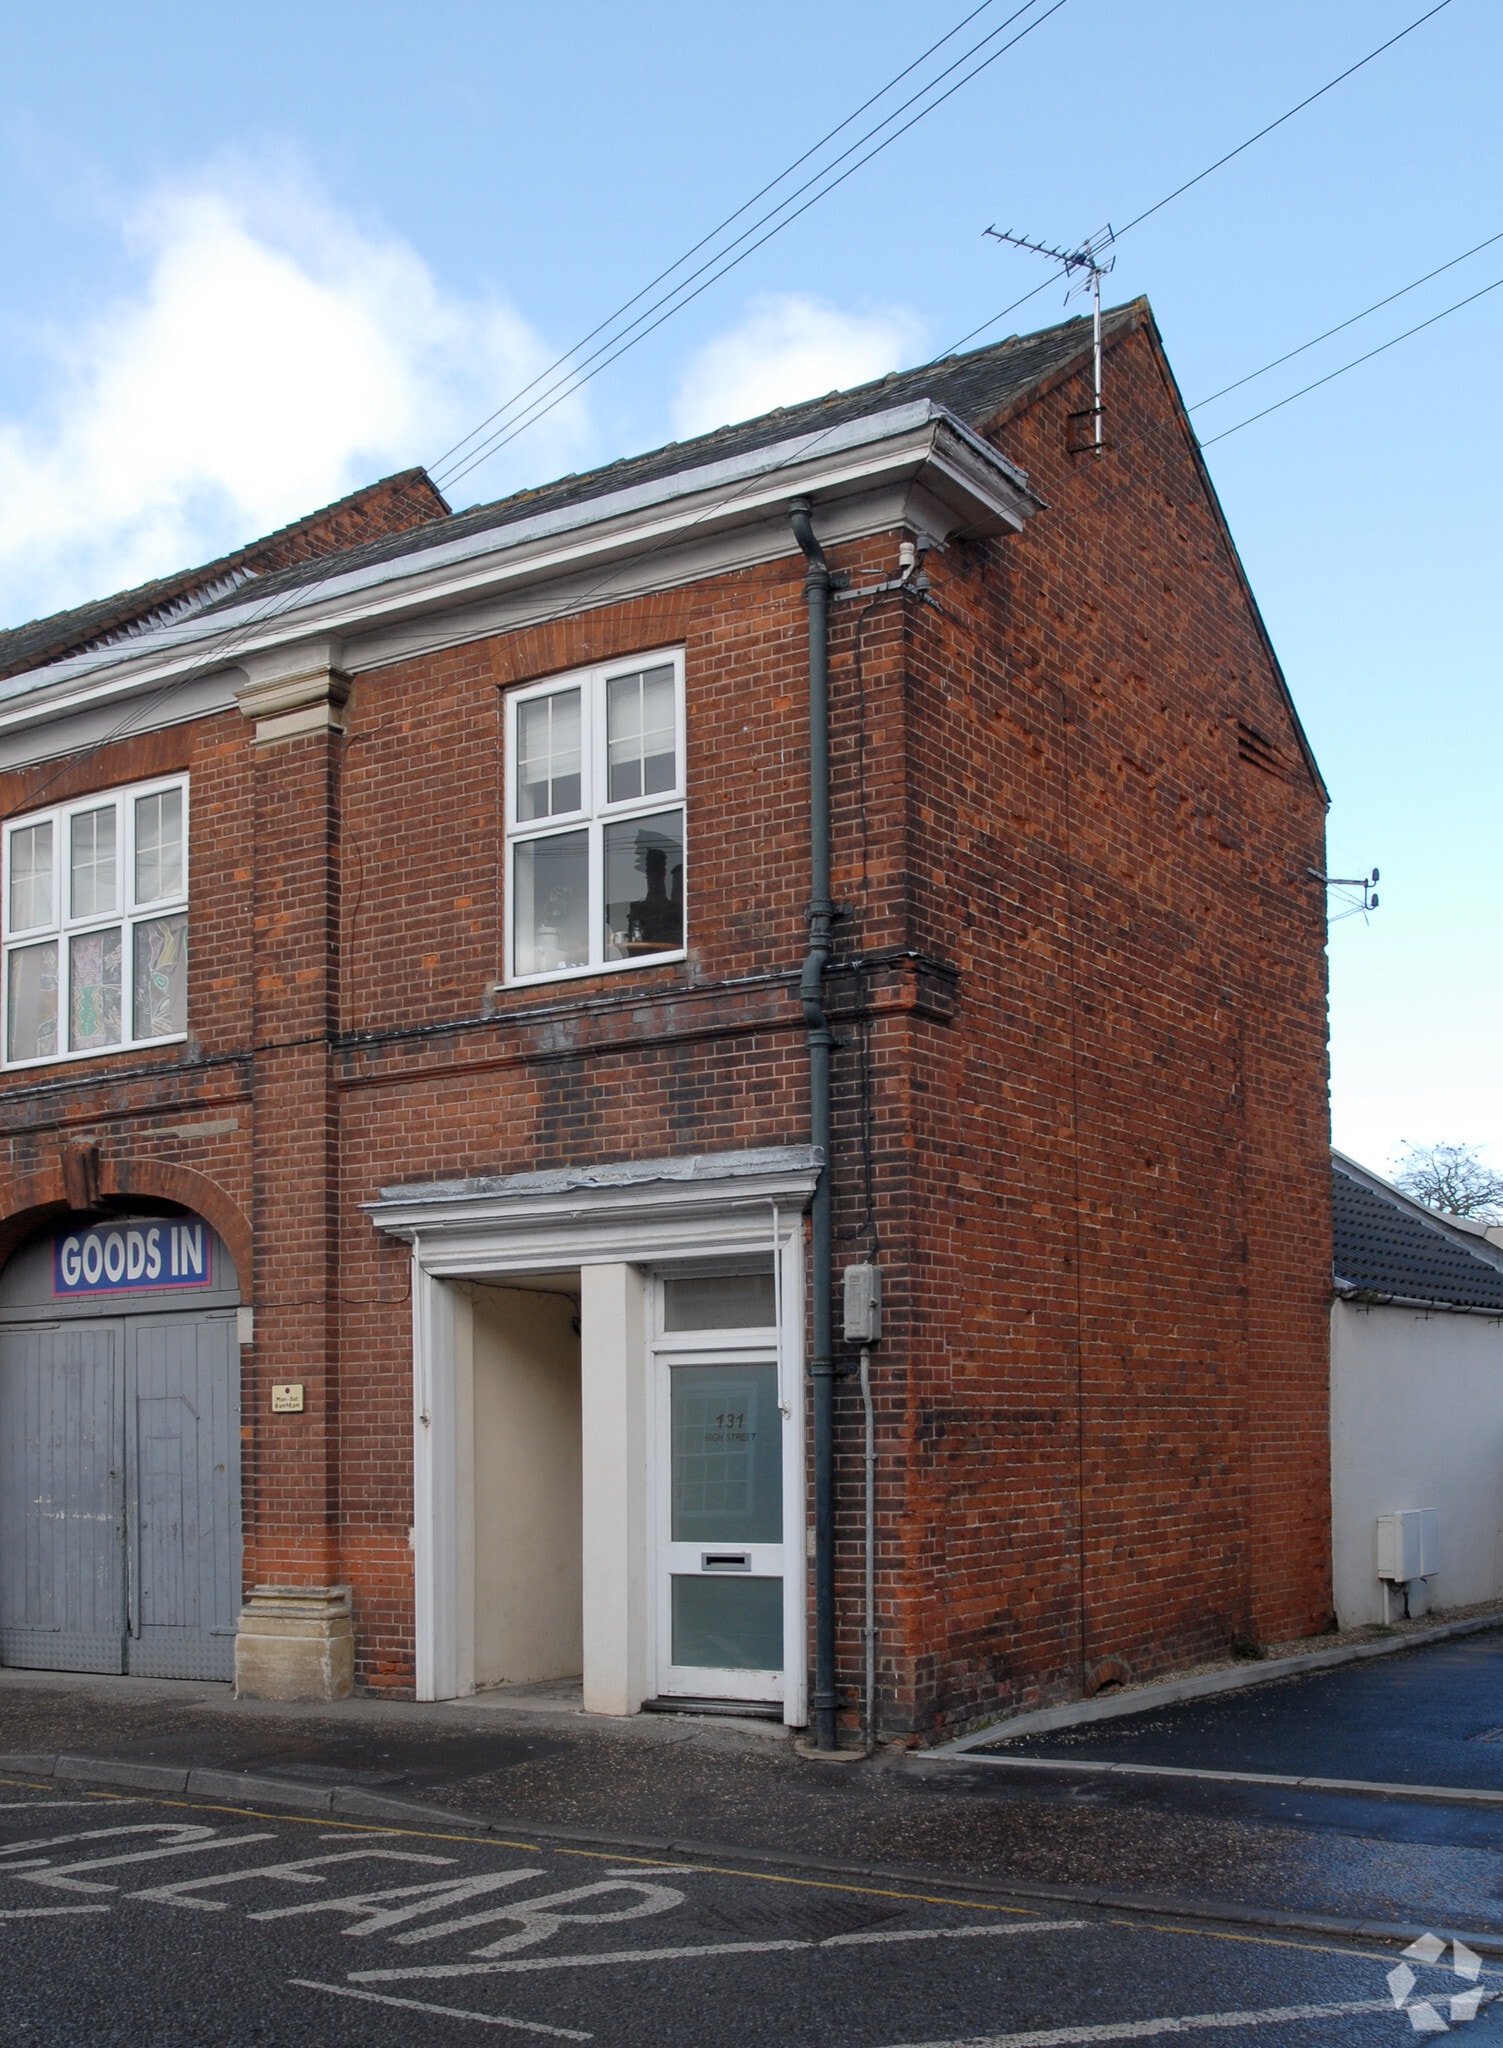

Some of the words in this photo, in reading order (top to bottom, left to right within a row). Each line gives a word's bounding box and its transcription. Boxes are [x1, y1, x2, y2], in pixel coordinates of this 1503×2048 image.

[61, 1228, 161, 1286] GOODS
[171, 1224, 202, 1276] IN
[716, 1413, 745, 1428] 131
[705, 1433, 724, 1441] HIGH
[726, 1432, 758, 1441] STREET
